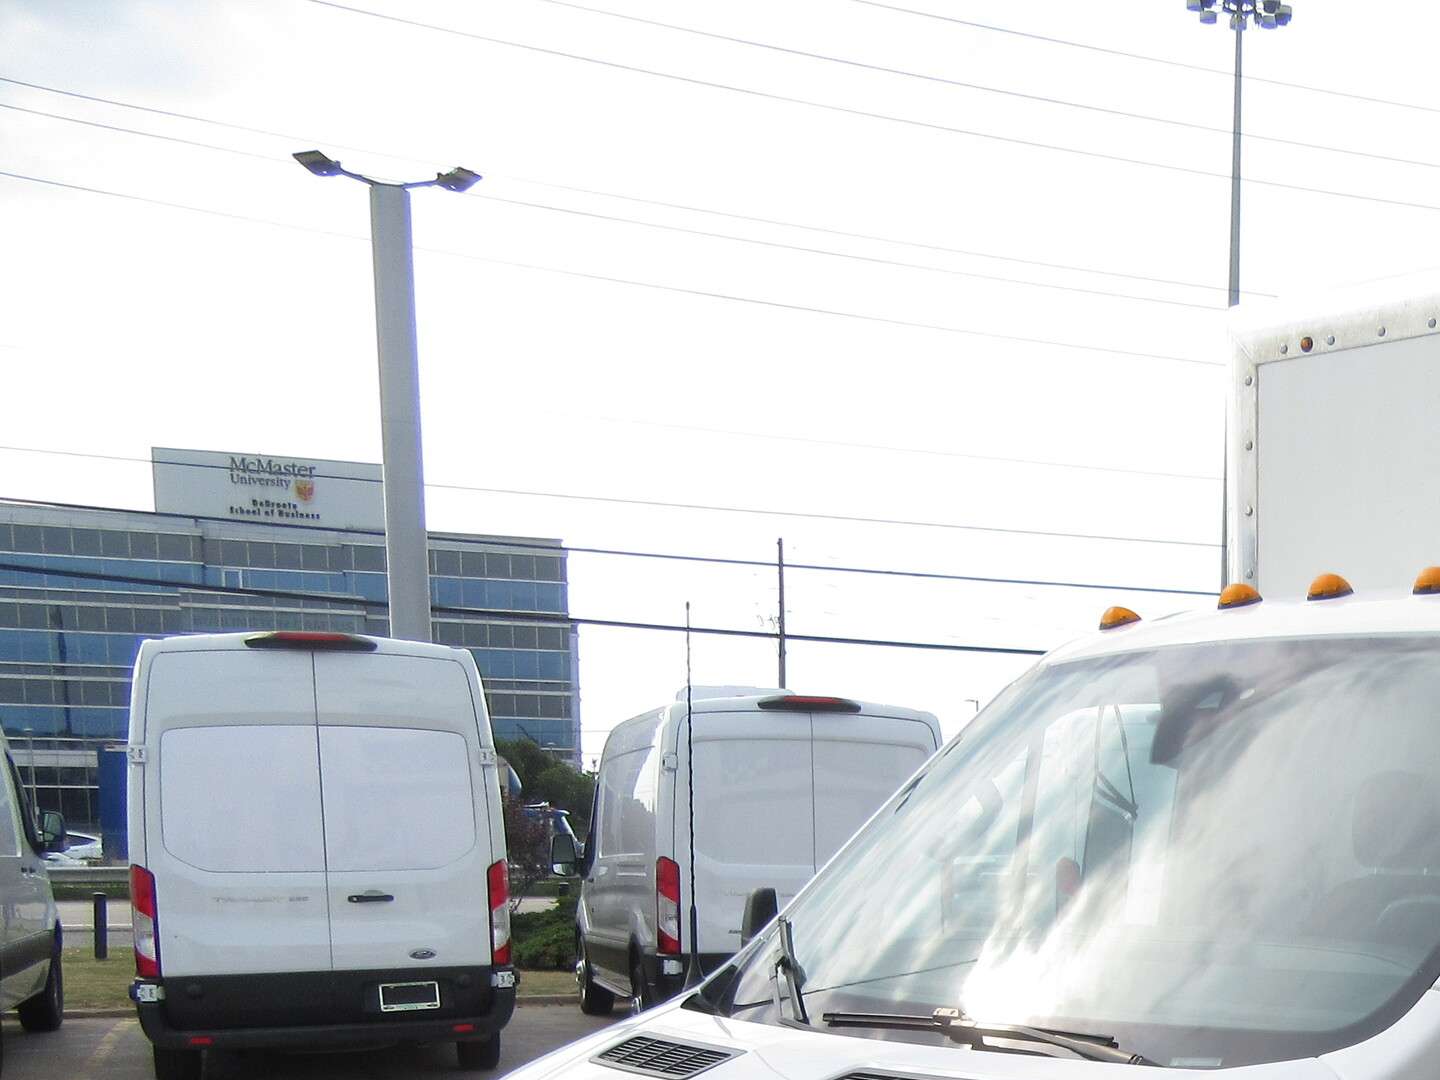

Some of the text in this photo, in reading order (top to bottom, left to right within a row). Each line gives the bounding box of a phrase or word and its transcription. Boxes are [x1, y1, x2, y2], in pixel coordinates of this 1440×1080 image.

[229, 456, 316, 478] McMaster
[229, 473, 291, 490] University
[229, 506, 320, 520] School of Business
